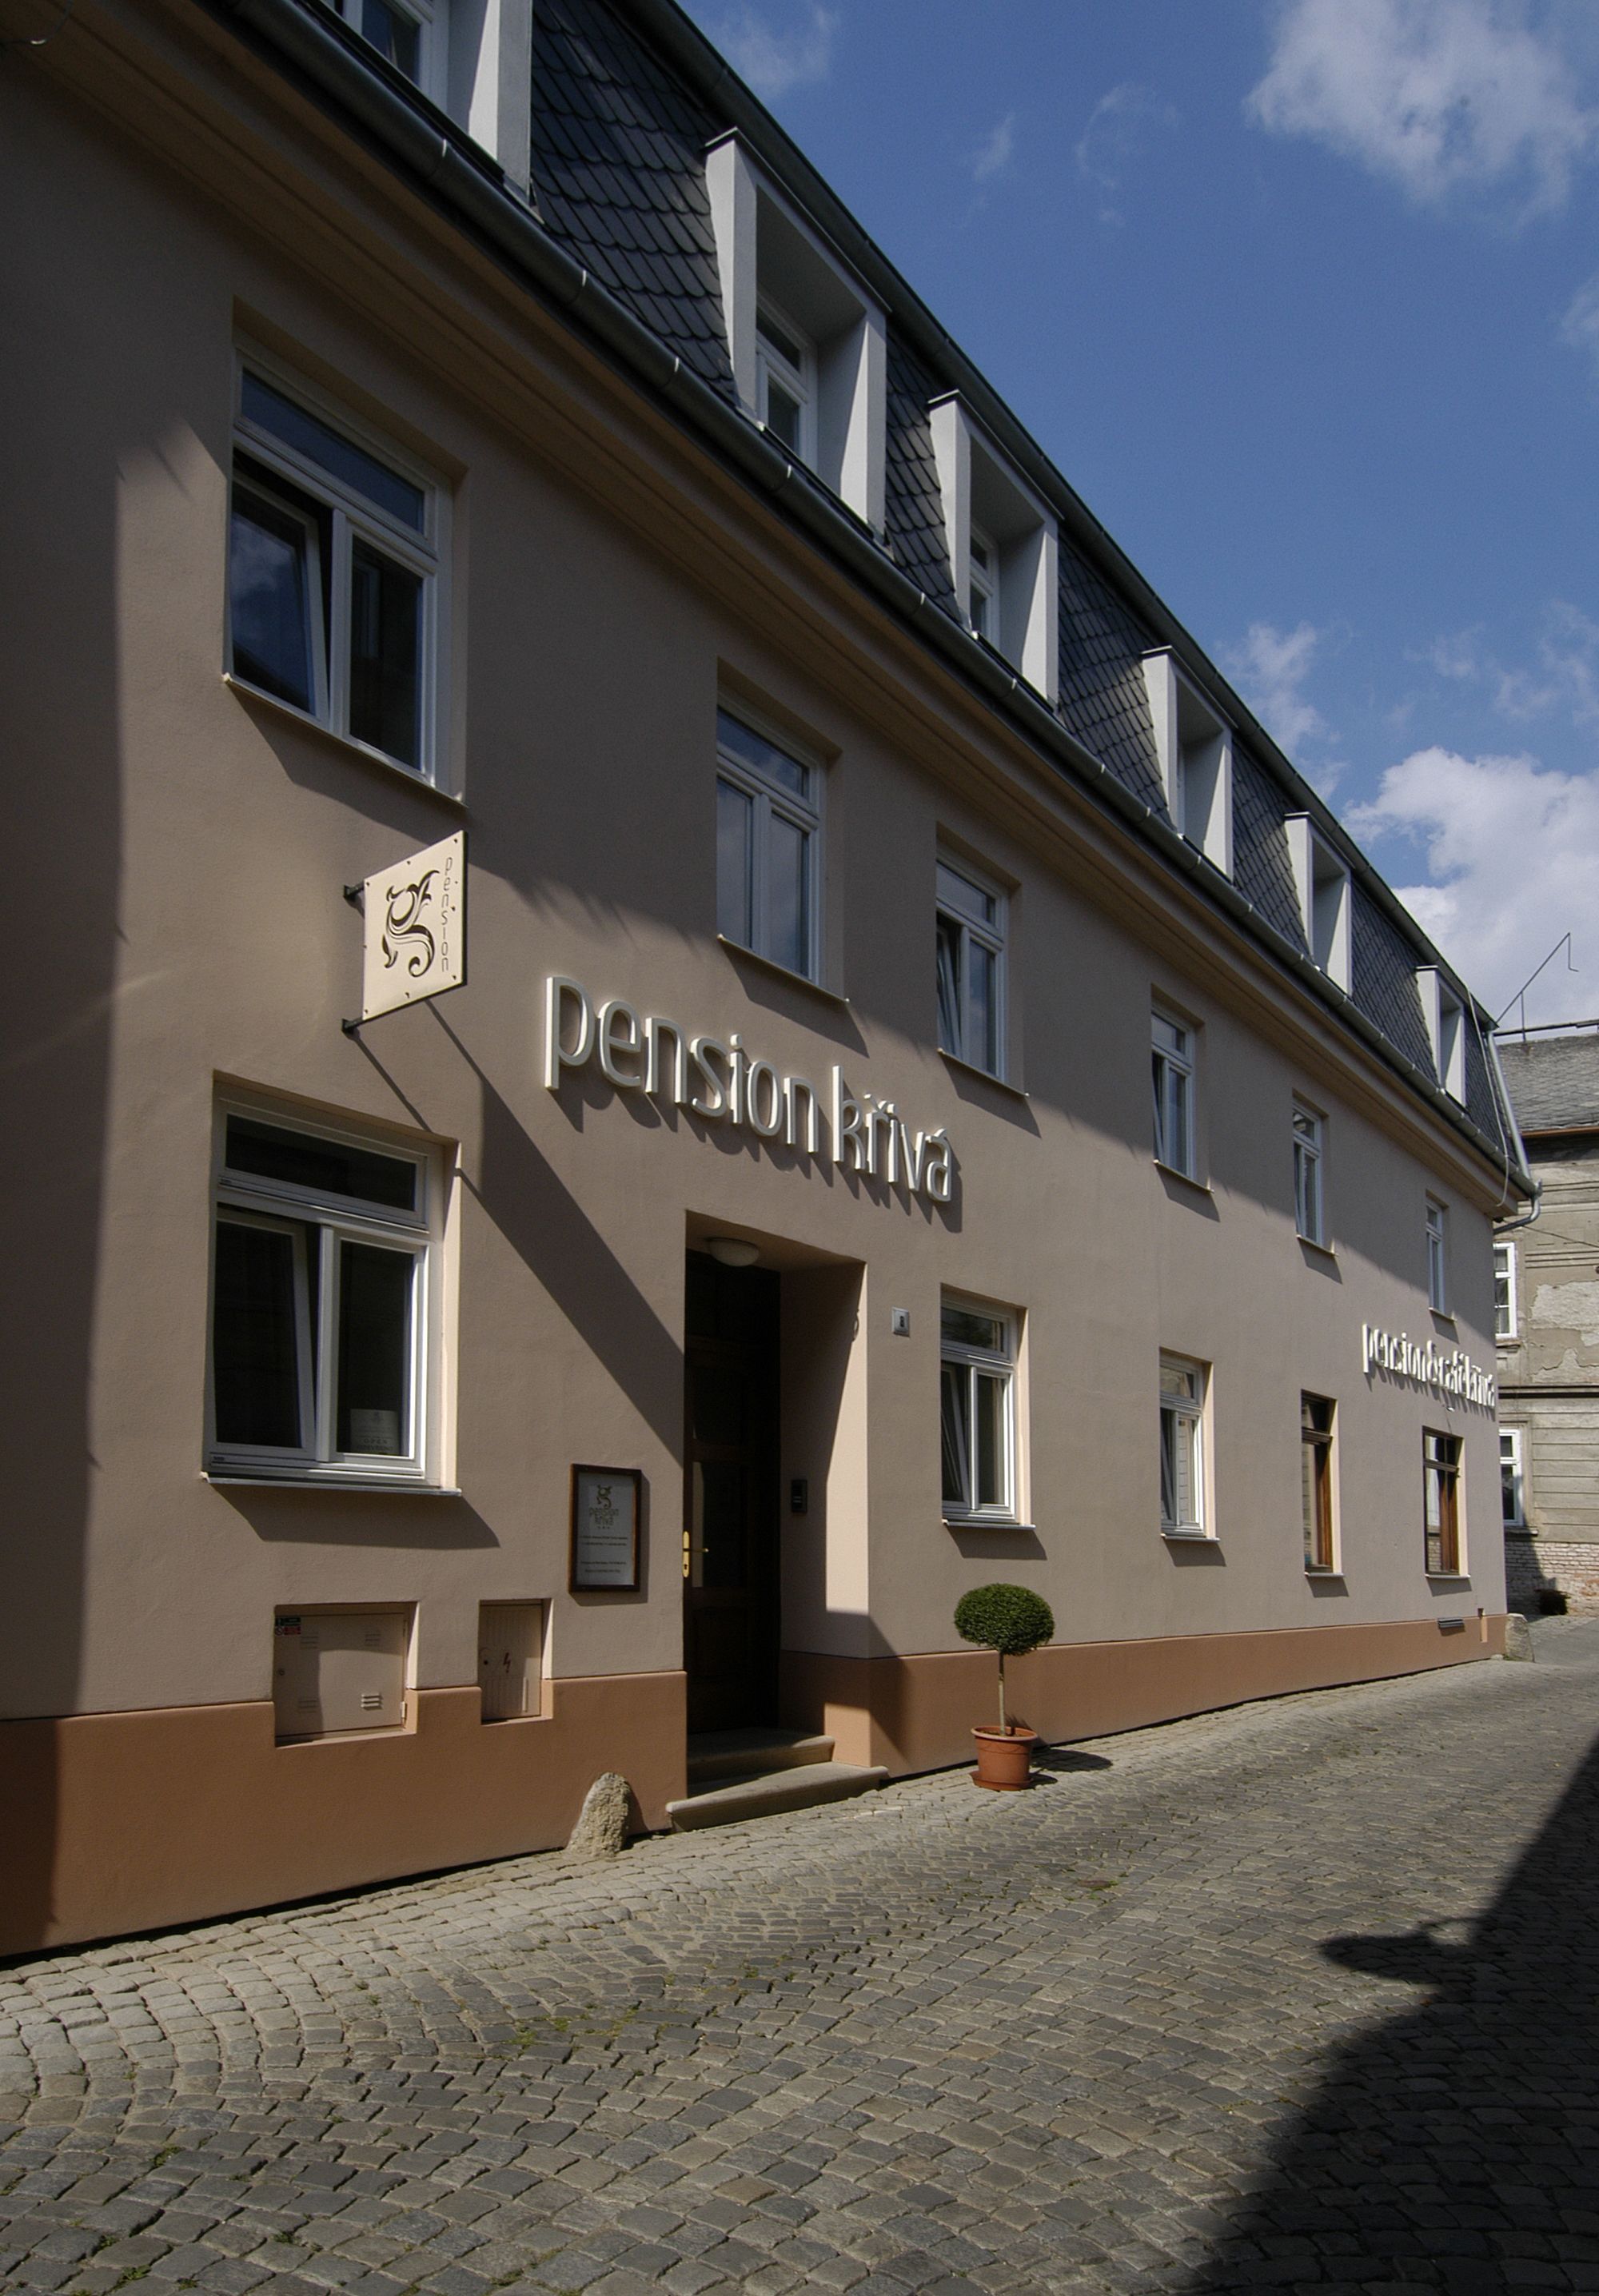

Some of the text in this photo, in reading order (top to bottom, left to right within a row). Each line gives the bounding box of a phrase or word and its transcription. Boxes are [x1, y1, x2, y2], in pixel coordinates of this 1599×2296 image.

[441, 856, 453, 973] pension
[544, 975, 952, 1203] pension křivá
